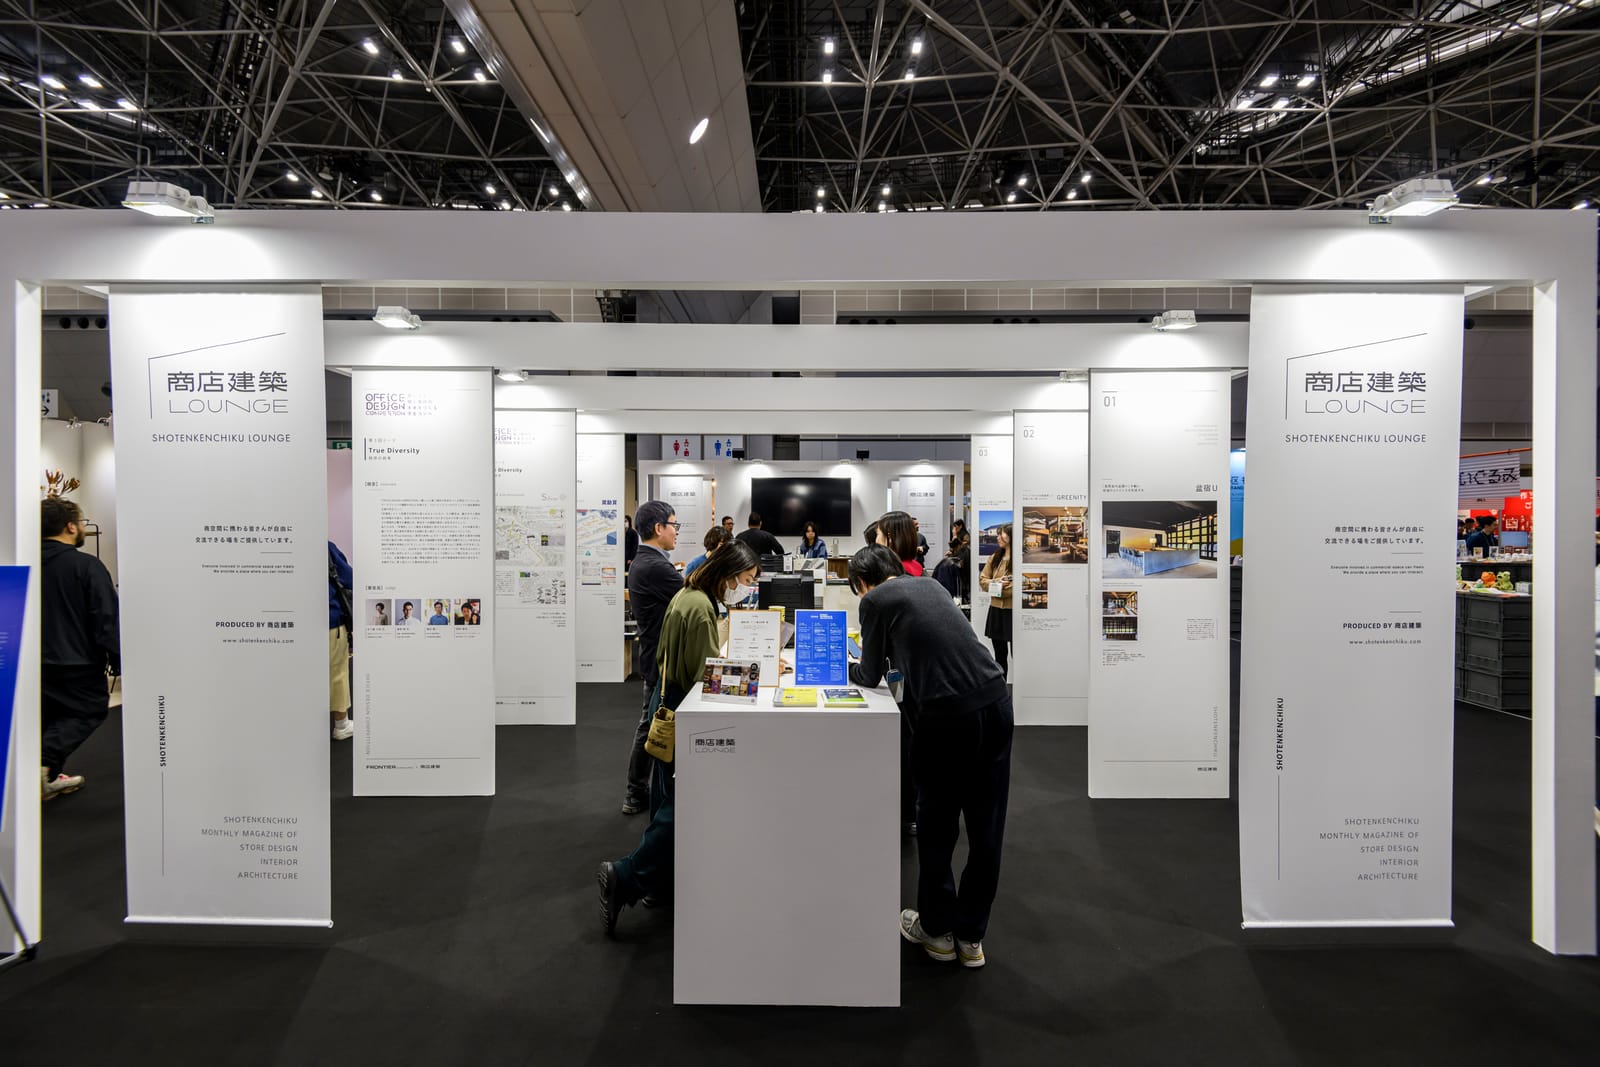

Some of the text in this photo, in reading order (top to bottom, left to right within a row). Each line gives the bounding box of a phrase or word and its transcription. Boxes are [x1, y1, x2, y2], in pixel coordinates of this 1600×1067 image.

[167, 371, 288, 393] 商店建築
[1305, 371, 1427, 393] 商店建築
[169, 399, 289, 414] LOUNGE
[1103, 395, 1116, 408] 01
[1305, 399, 1427, 414] LOUNGE
[152, 433, 291, 443] SHOTENKENCHIKU LOUNGE
[1023, 429, 1035, 439] 02
[1285, 433, 1427, 443] SHOTENKENCHIKU LOUNGE
[387, 447, 420, 455] Diversity
[158, 695, 167, 767] SHOTENKENCHIKU
[1276, 697, 1284, 771] SHOTENKENCHIKU
[695, 738, 736, 747] 商店建築
[223, 816, 298, 825] SHOTENKENCHIKU
[1344, 817, 1420, 826] SHOTENKENCHIKU
[201, 828, 298, 839] MONTHLY MAGAZINE OF
[1319, 831, 1419, 840] MONTHLY MAGAZINE OF
[239, 843, 298, 853] STORE DESIGN
[1360, 844, 1419, 853] STORE DESIGN
[260, 857, 299, 867] INTERIOR
[1379, 858, 1419, 867] INTERIOR
[237, 871, 299, 881] ARCHITECTURE
[1357, 872, 1419, 881] ARCHITECTURE
